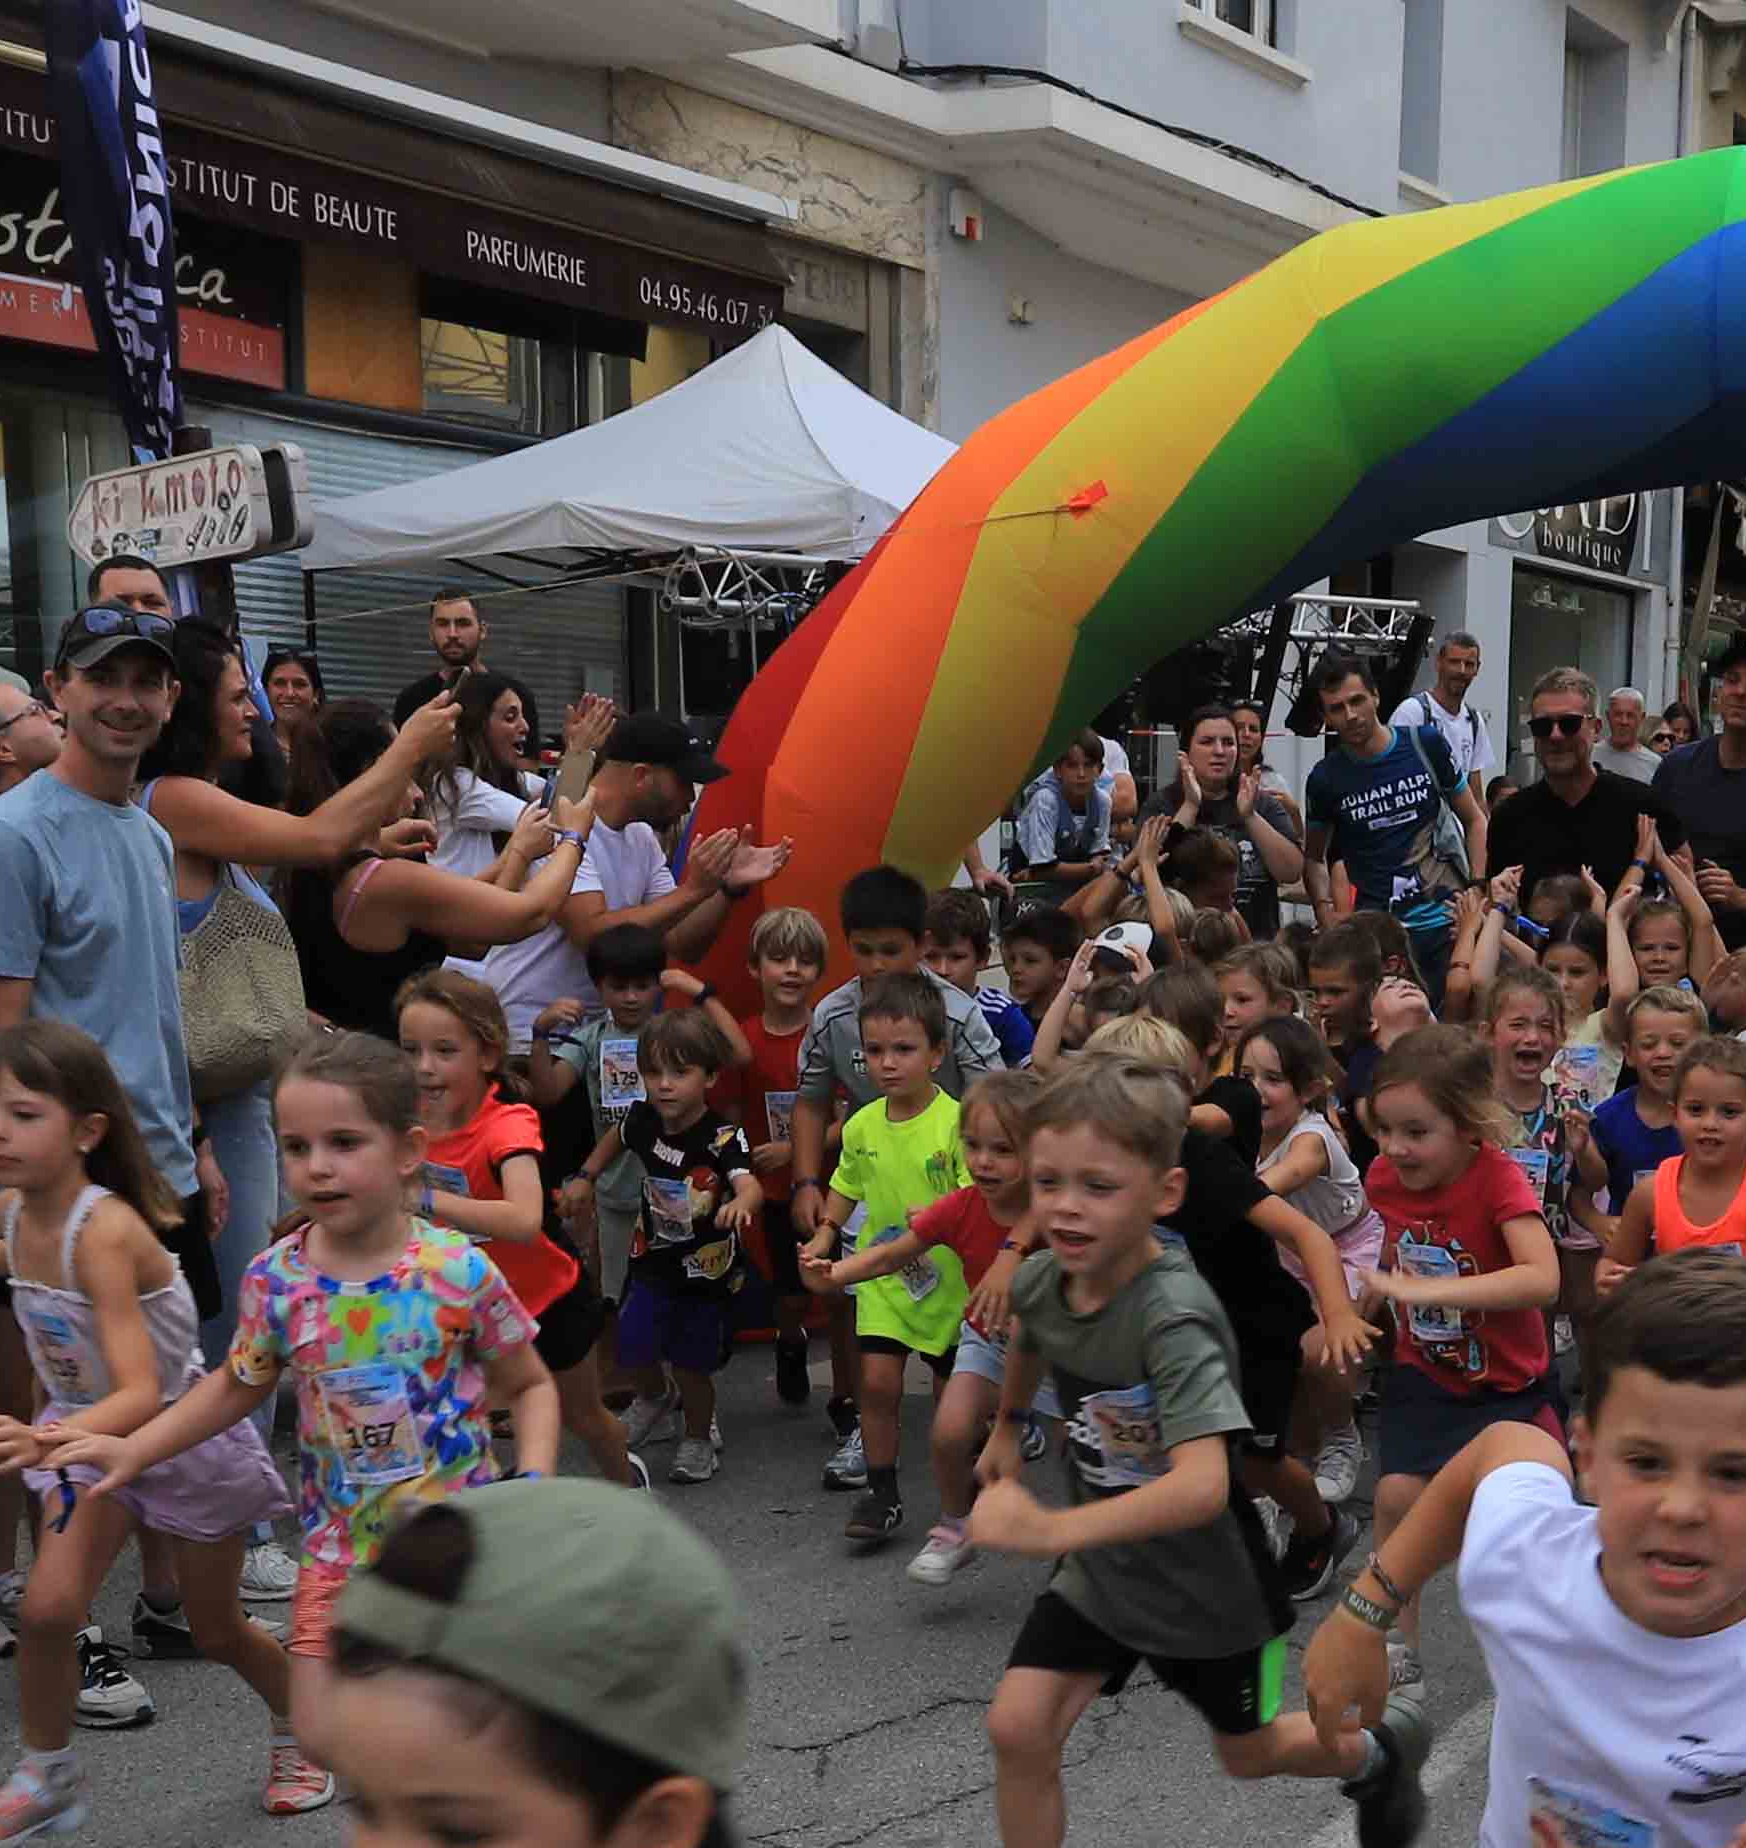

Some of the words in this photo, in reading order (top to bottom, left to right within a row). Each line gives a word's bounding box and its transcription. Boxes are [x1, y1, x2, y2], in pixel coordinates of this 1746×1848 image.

[166, 157, 258, 206] STITUT
[271, 182, 300, 217] DE
[314, 194, 398, 241] BEAUTE
[466, 230, 587, 286] PARFUMERIE
[180, 325, 266, 361] STITUT
[1542, 521, 1622, 567] boutique
[1341, 783, 1393, 810] JULIAN
[1350, 801, 1392, 822] TRAIL
[1395, 788, 1429, 809] RUN
[611, 1071, 639, 1086] 179
[347, 1422, 396, 1452] 167
